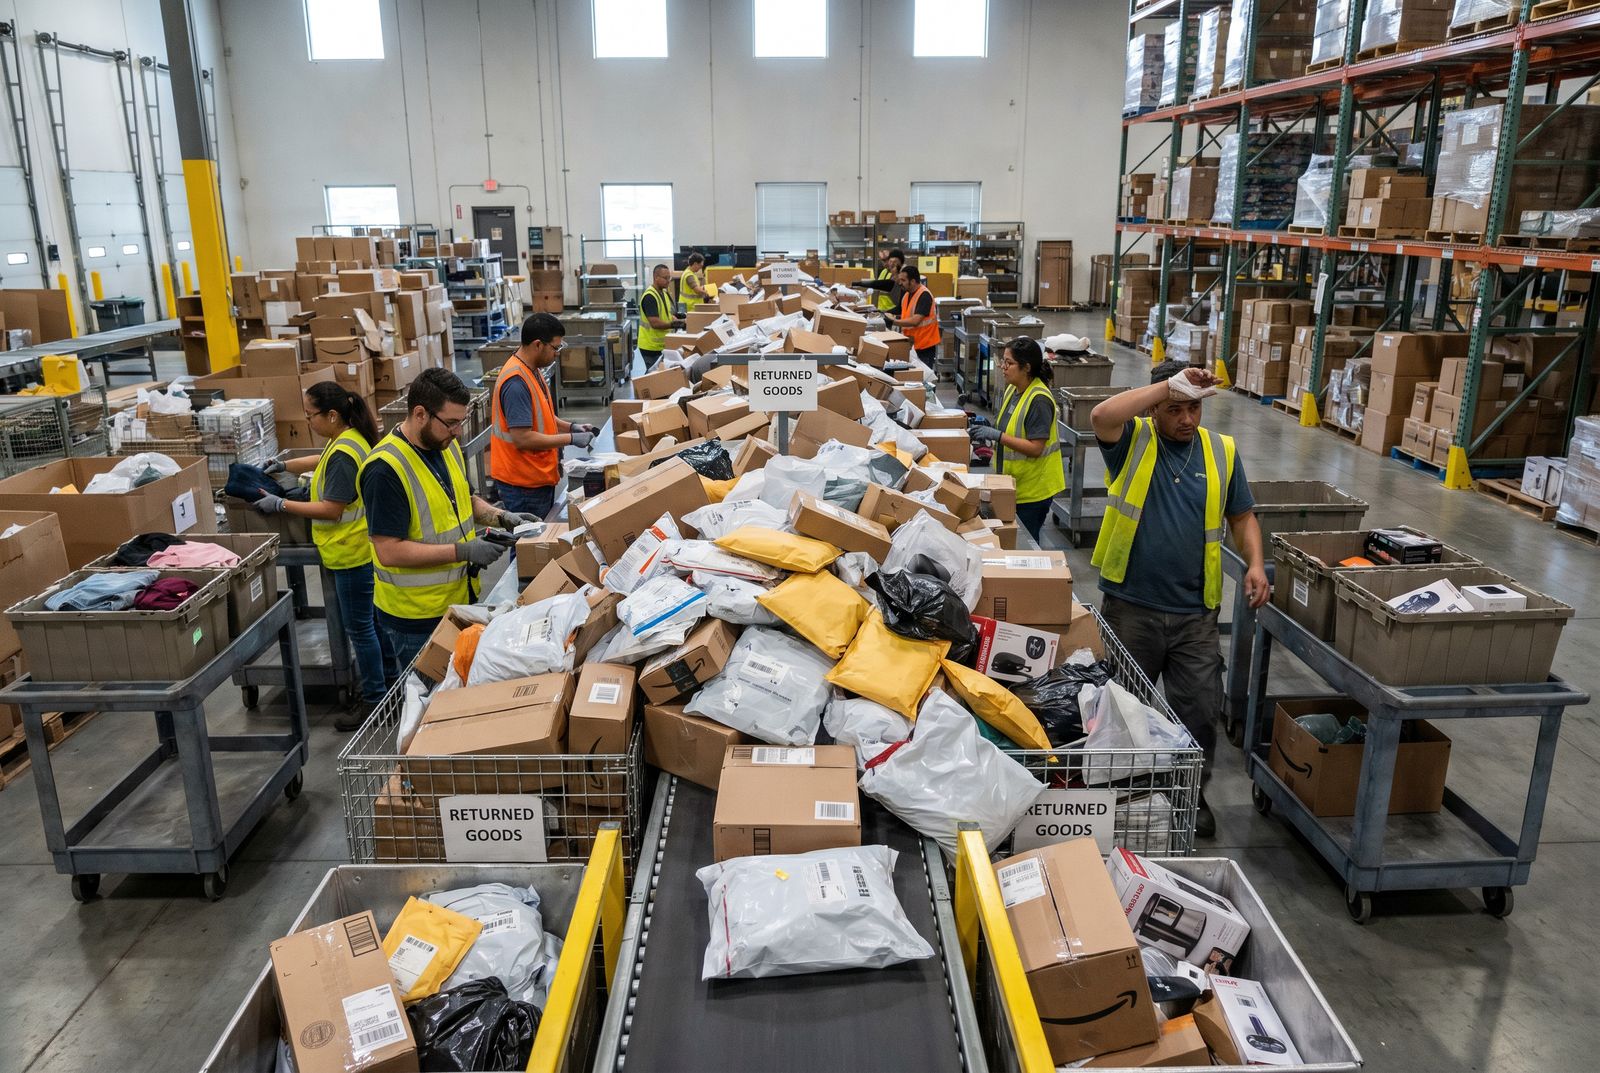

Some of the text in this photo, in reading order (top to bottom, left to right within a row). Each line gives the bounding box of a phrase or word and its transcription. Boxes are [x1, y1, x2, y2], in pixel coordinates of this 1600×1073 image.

[753, 370, 813, 380] RETURNED
[763, 386, 803, 396] GOODS
[449, 808, 534, 821] RETURNED
[465, 829, 523, 842] GOODS
[1035, 823, 1093, 836] GOODS
